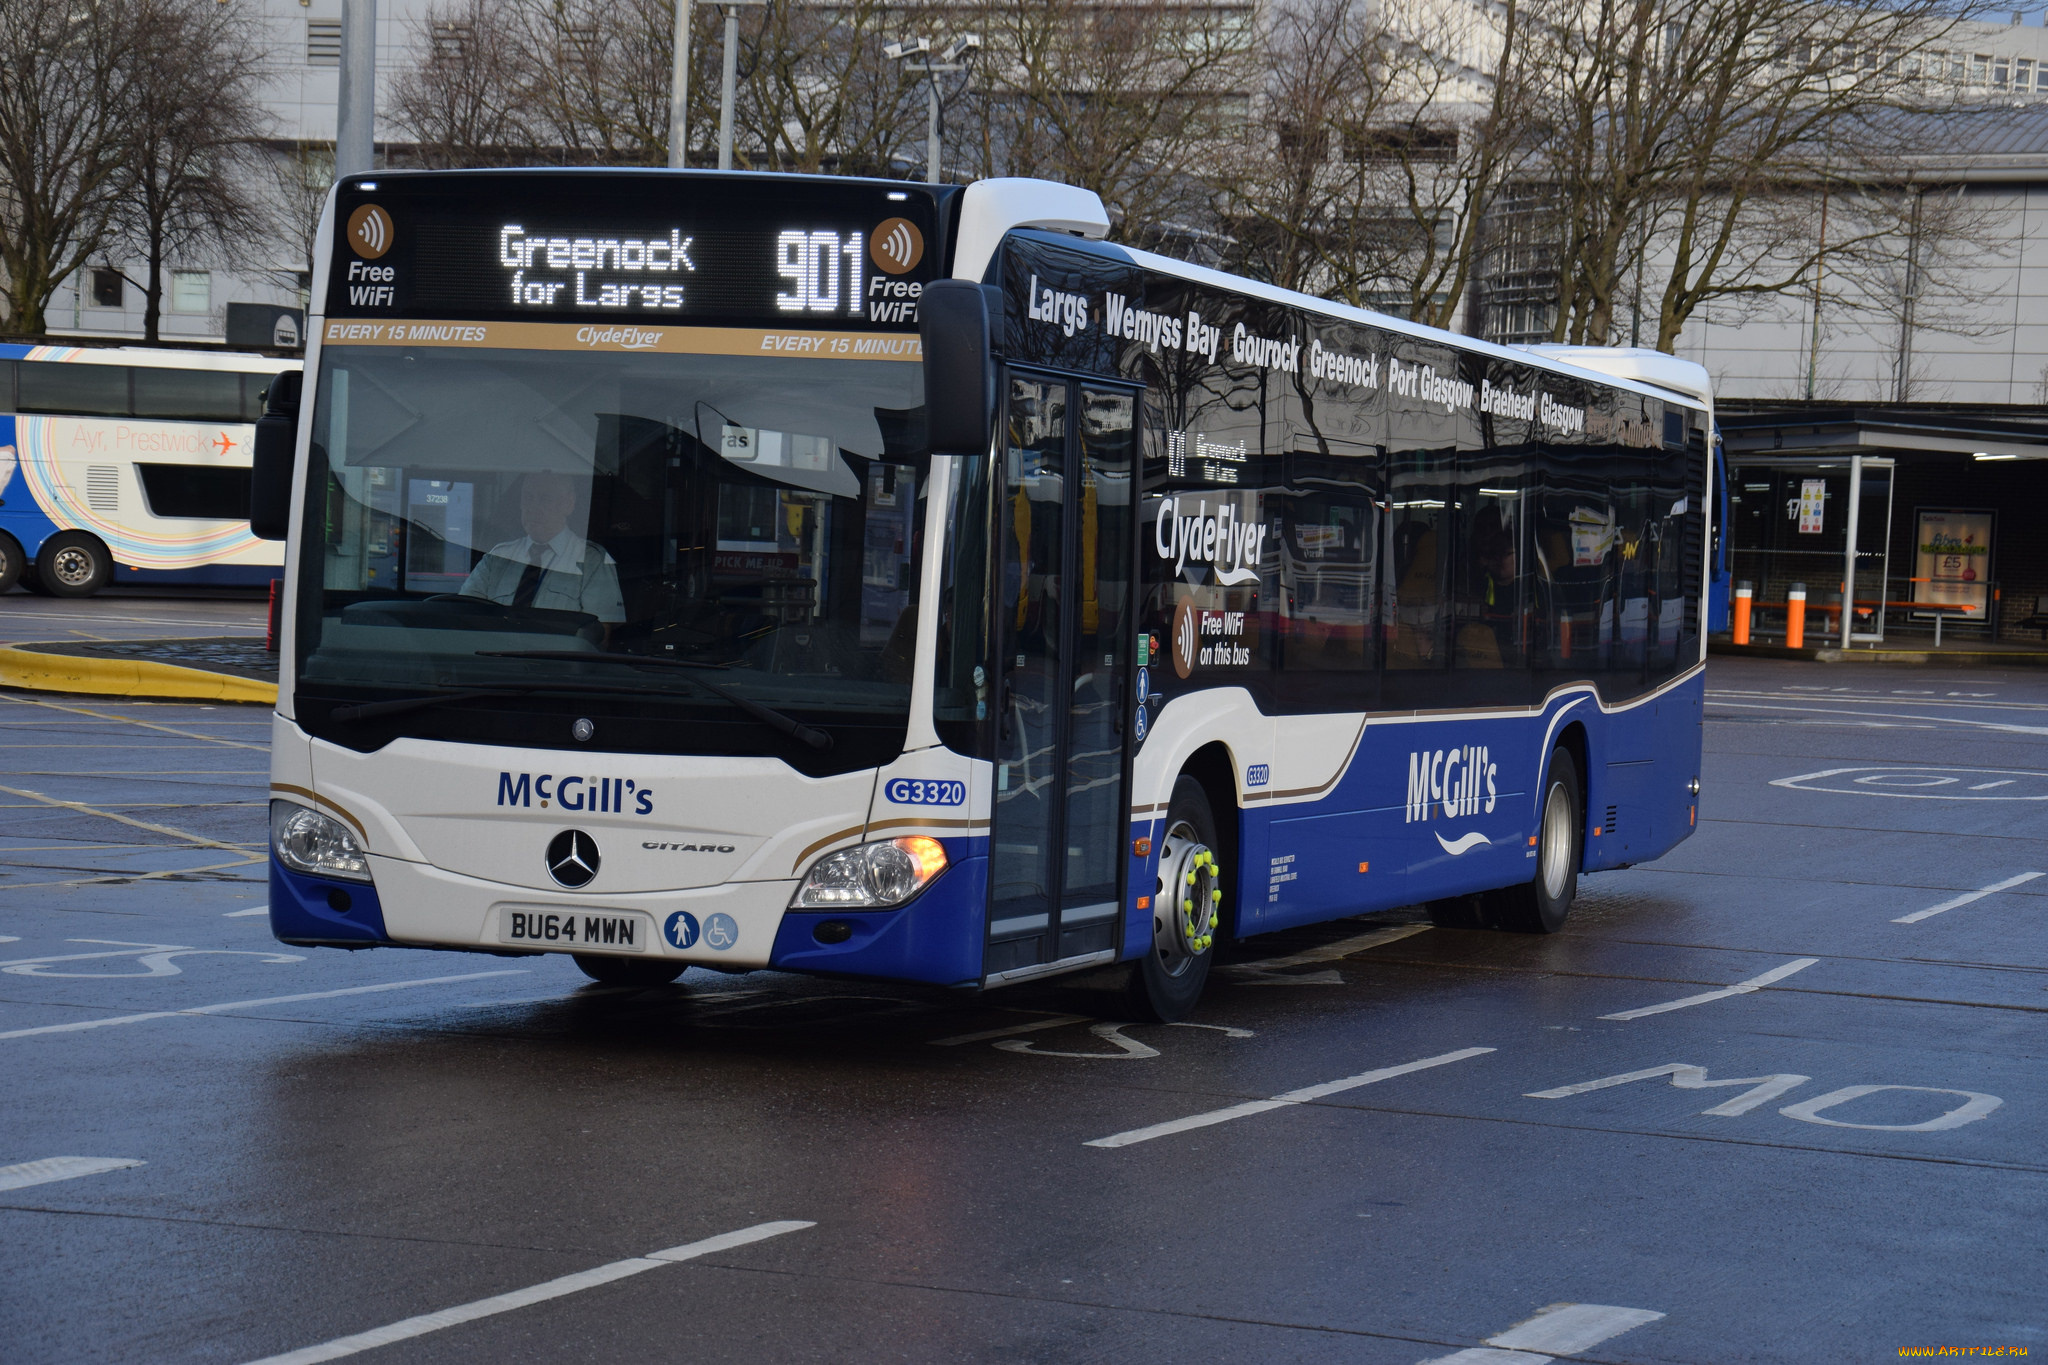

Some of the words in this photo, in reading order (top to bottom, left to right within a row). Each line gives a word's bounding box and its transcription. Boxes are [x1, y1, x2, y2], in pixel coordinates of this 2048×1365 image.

[501, 225, 695, 270] Greenock
[348, 262, 395, 282] Free
[777, 231, 863, 312] 901
[350, 286, 394, 306] WiFi
[511, 270, 565, 304] for
[575, 272, 684, 307] Largs
[868, 276, 923, 298] Free
[327, 325, 384, 340] EVERY
[387, 326, 405, 340] 15
[408, 326, 487, 342] MINUTES
[576, 327, 663, 348] ClydeFlyer
[761, 335, 826, 351] EVERY
[829, 338, 850, 354] 15
[1028, 274, 1088, 337] Largs
[1106, 292, 1181, 353] Wemyss
[1186, 311, 1220, 365] Bay
[1233, 322, 1300, 373] Gourock
[1311, 339, 1378, 389] Greenock
[1388, 357, 1417, 398] Port
[1421, 364, 1474, 413] Glasgow
[1481, 379, 1535, 421] Braehead
[1540, 392, 1585, 435] Glasgow
[72, 424, 108, 454] Ayr,
[116, 426, 209, 453] Prestwick
[1156, 497, 1267, 578] ClydeFlyer
[714, 556, 741, 569] PICK
[745, 557, 763, 570] ME
[1201, 612, 1222, 635] Free
[1224, 612, 1244, 636] WiFi
[1200, 648, 1212, 665] on
[1214, 643, 1230, 665] this
[1232, 644, 1250, 666] bus
[1248, 766, 1268, 785] G3320
[1406, 745, 1496, 824] McGill's
[497, 772, 653, 815] McGill's
[891, 781, 963, 804] G3320
[642, 841, 735, 853] CITARO
[511, 912, 576, 942] BU64
[584, 916, 635, 945] MWN
